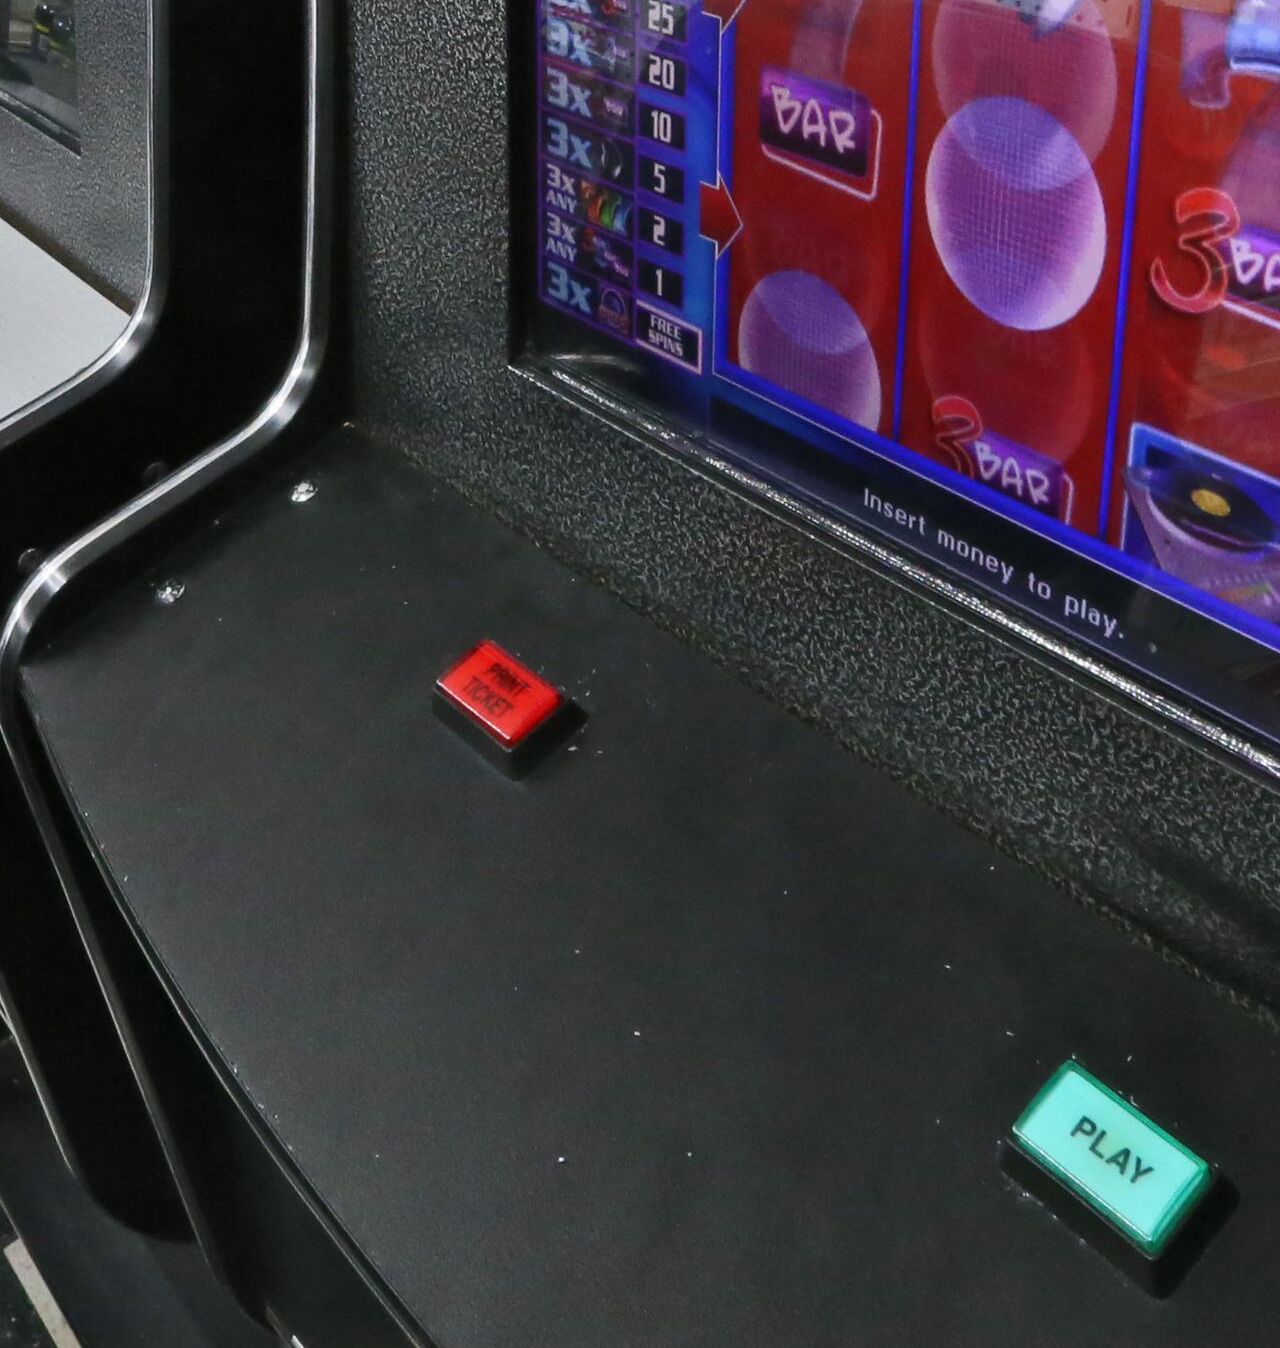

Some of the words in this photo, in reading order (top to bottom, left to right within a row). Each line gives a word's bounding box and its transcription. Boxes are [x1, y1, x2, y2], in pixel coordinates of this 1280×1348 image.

[648, 53, 676, 91] 20
[650, 109, 673, 145] 10
[770, 84, 857, 153] BAR
[653, 162, 667, 195] 5
[546, 188, 578, 217] ANY
[652, 214, 666, 247] 2
[546, 240, 578, 263] ANY
[654, 267, 664, 297] 1
[648, 330, 684, 357] SPINS
[650, 313, 682, 342] FREE
[974, 440, 1050, 505] BAR
[863, 486, 926, 536] Insert
[937, 527, 1014, 586] money
[1027, 571, 1052, 601] to
[1064, 593, 1125, 640] play.
[462, 675, 514, 719] TICKET
[1069, 1115, 1155, 1184] PLAY
